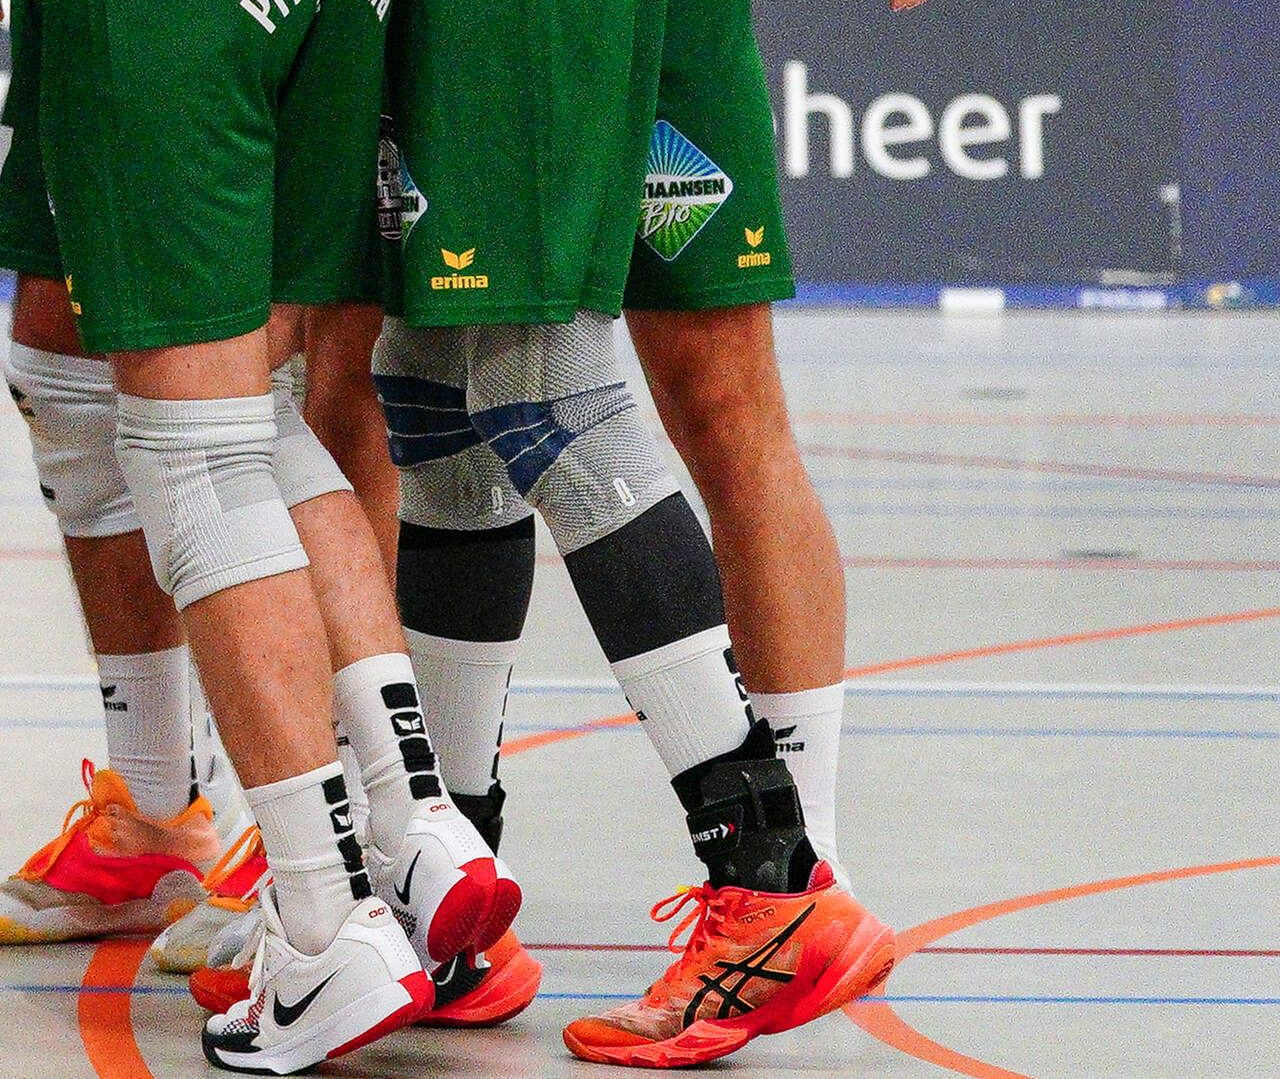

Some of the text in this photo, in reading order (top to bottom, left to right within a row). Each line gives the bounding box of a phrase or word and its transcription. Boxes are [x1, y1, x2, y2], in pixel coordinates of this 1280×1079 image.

[783, 60, 1062, 180] heer
[737, 251, 772, 269] erima
[430, 273, 489, 290] erima
